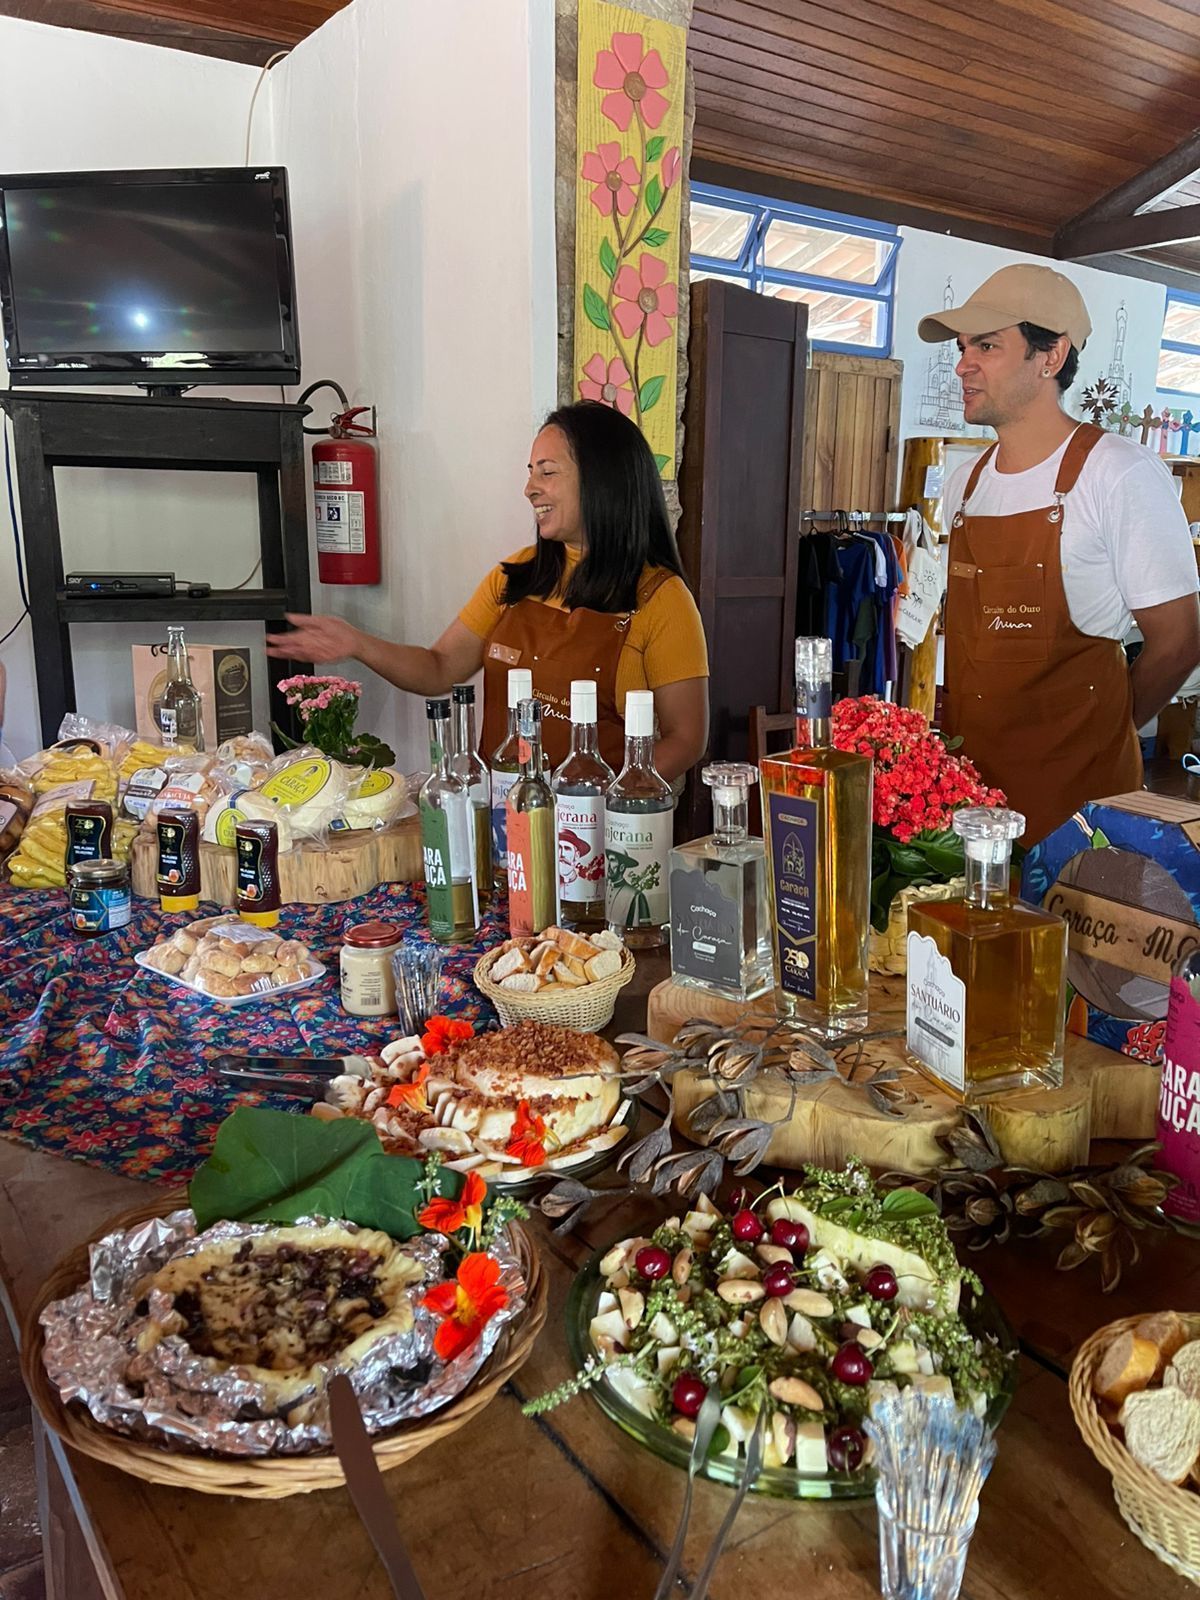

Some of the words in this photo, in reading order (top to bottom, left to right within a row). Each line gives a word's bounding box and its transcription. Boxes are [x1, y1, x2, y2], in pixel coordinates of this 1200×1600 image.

[67, 577, 83, 585] SKY
[1007, 604, 1017, 614] do
[1019, 604, 1041, 613] Ouro
[987, 615, 1033, 631] Minas
[532, 688, 559, 704] Circuito
[560, 696, 571, 707] do
[690, 904, 717, 918] Cachaça
[1049, 894, 1119, 949] Caraça
[783, 947, 810, 970] 250
